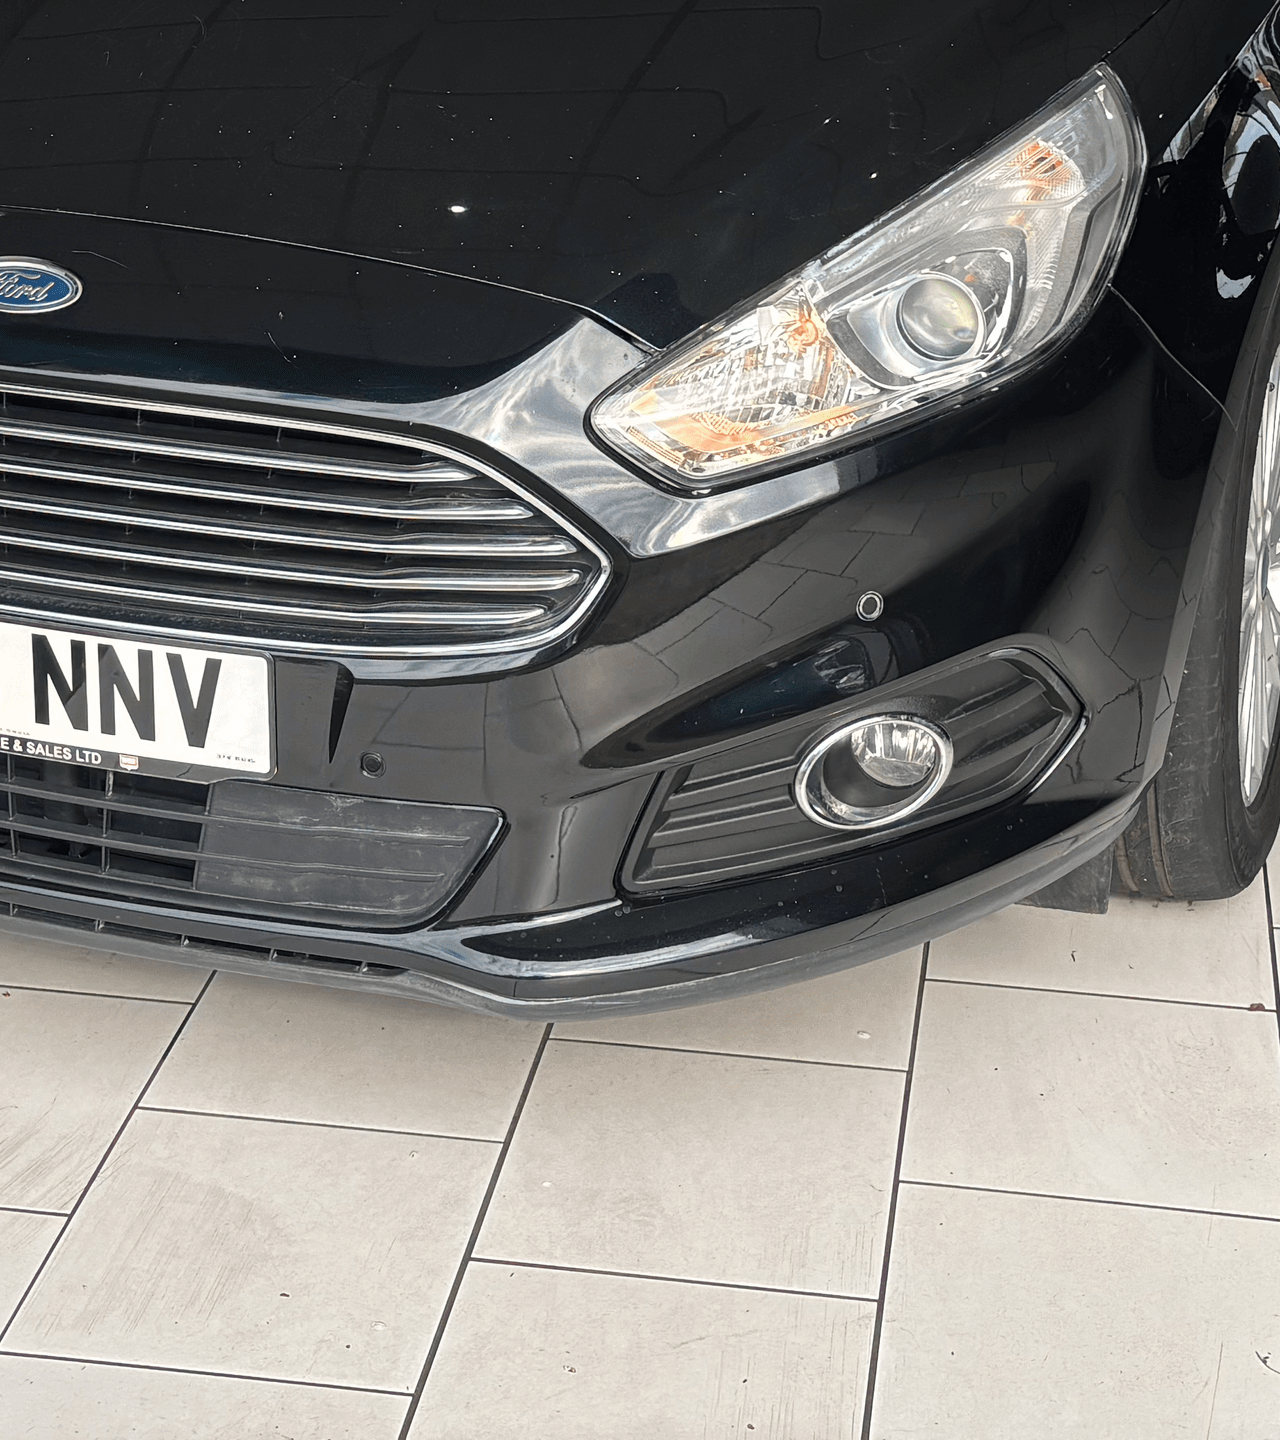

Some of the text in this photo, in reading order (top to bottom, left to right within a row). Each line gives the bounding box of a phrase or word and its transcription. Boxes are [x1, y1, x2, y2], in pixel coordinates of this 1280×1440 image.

[31, 633, 222, 748] NNV
[13, 739, 23, 752] &
[26, 741, 72, 760] SALES
[75, 749, 102, 765] LTD
